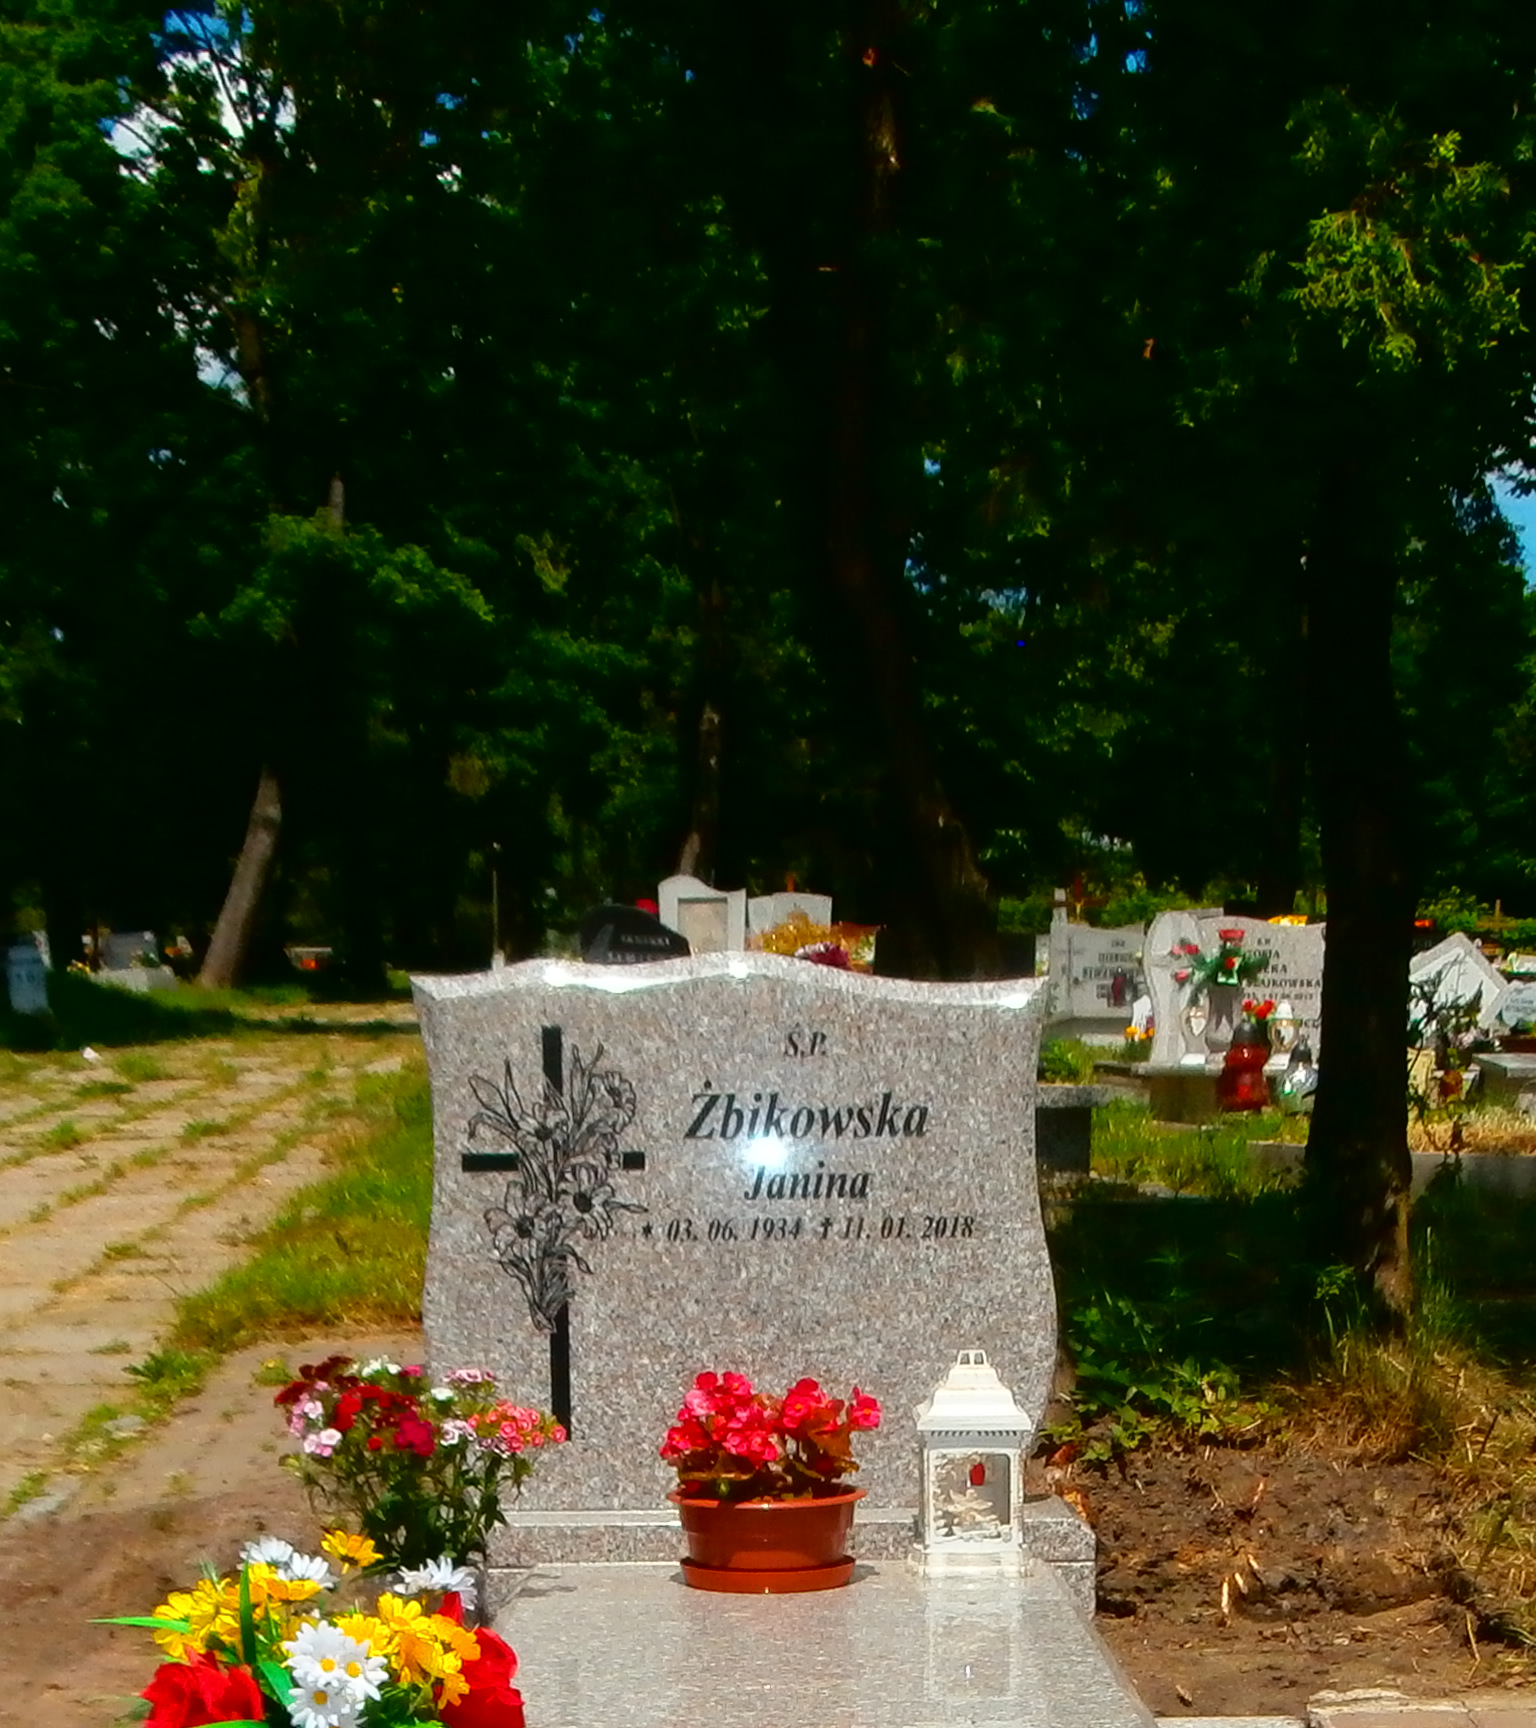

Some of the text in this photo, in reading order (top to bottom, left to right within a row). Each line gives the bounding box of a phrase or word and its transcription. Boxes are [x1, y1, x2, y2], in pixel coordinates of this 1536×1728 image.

[683, 1078, 931, 1140] Żbikowska
[743, 1160, 873, 1201] Janina
[750, 1215, 804, 1242] 1934
[920, 1213, 975, 1240] 2018
